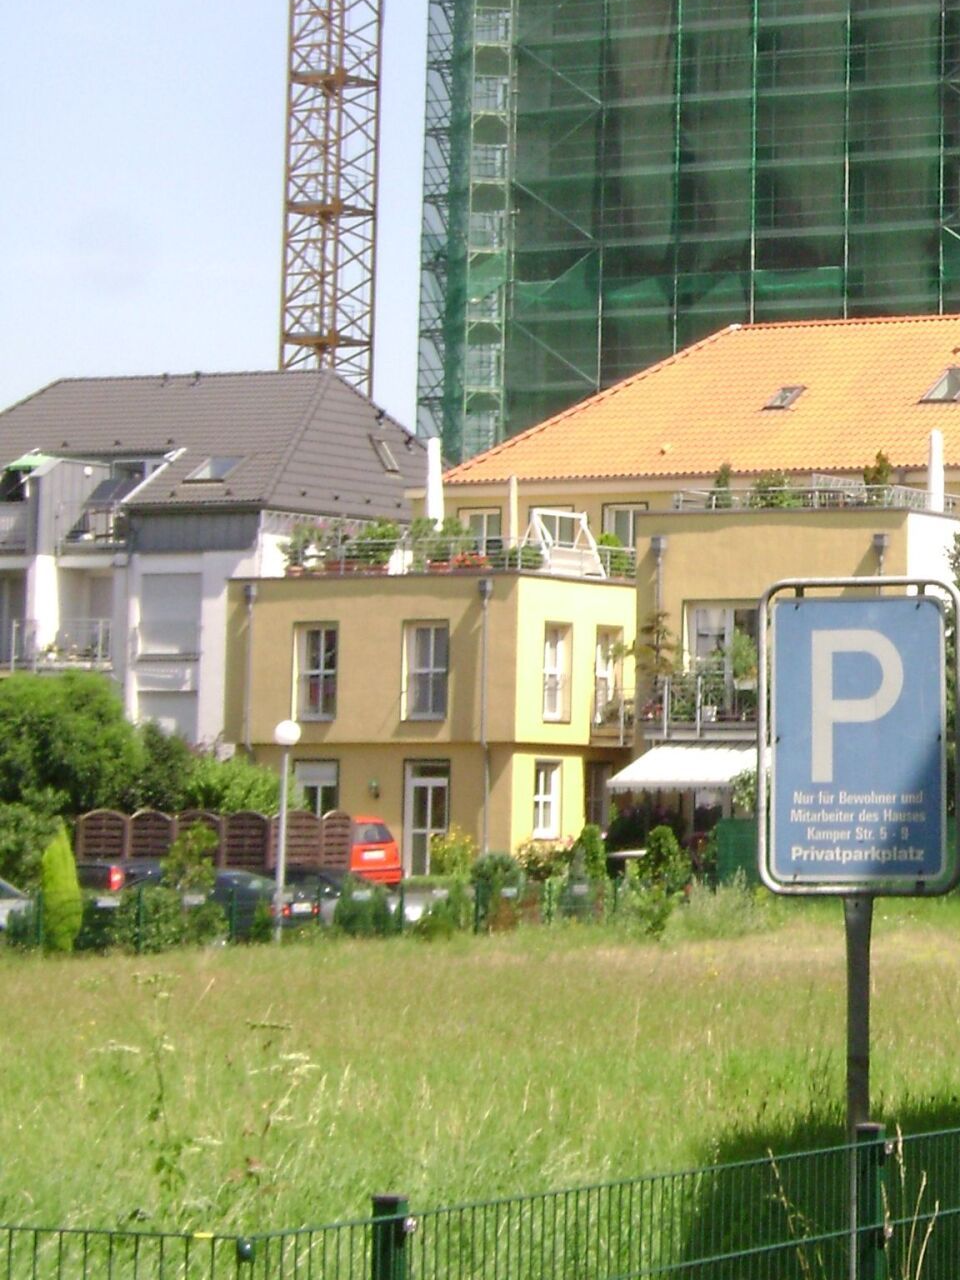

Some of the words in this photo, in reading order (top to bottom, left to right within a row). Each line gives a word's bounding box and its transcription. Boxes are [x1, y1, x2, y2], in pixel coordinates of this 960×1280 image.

[811, 629, 904, 782] P
[793, 791, 814, 804] Nur
[819, 791, 834, 804] für
[839, 791, 896, 804] Bewohner
[901, 791, 923, 803] und
[790, 809, 854, 822] Mitarbeiter
[859, 809, 879, 822] des
[884, 809, 926, 822] Hauses
[807, 827, 851, 843] Kamper
[855, 827, 875, 840] Str.
[880, 827, 888, 840] 5
[791, 846, 924, 864] Privatparkplatz
